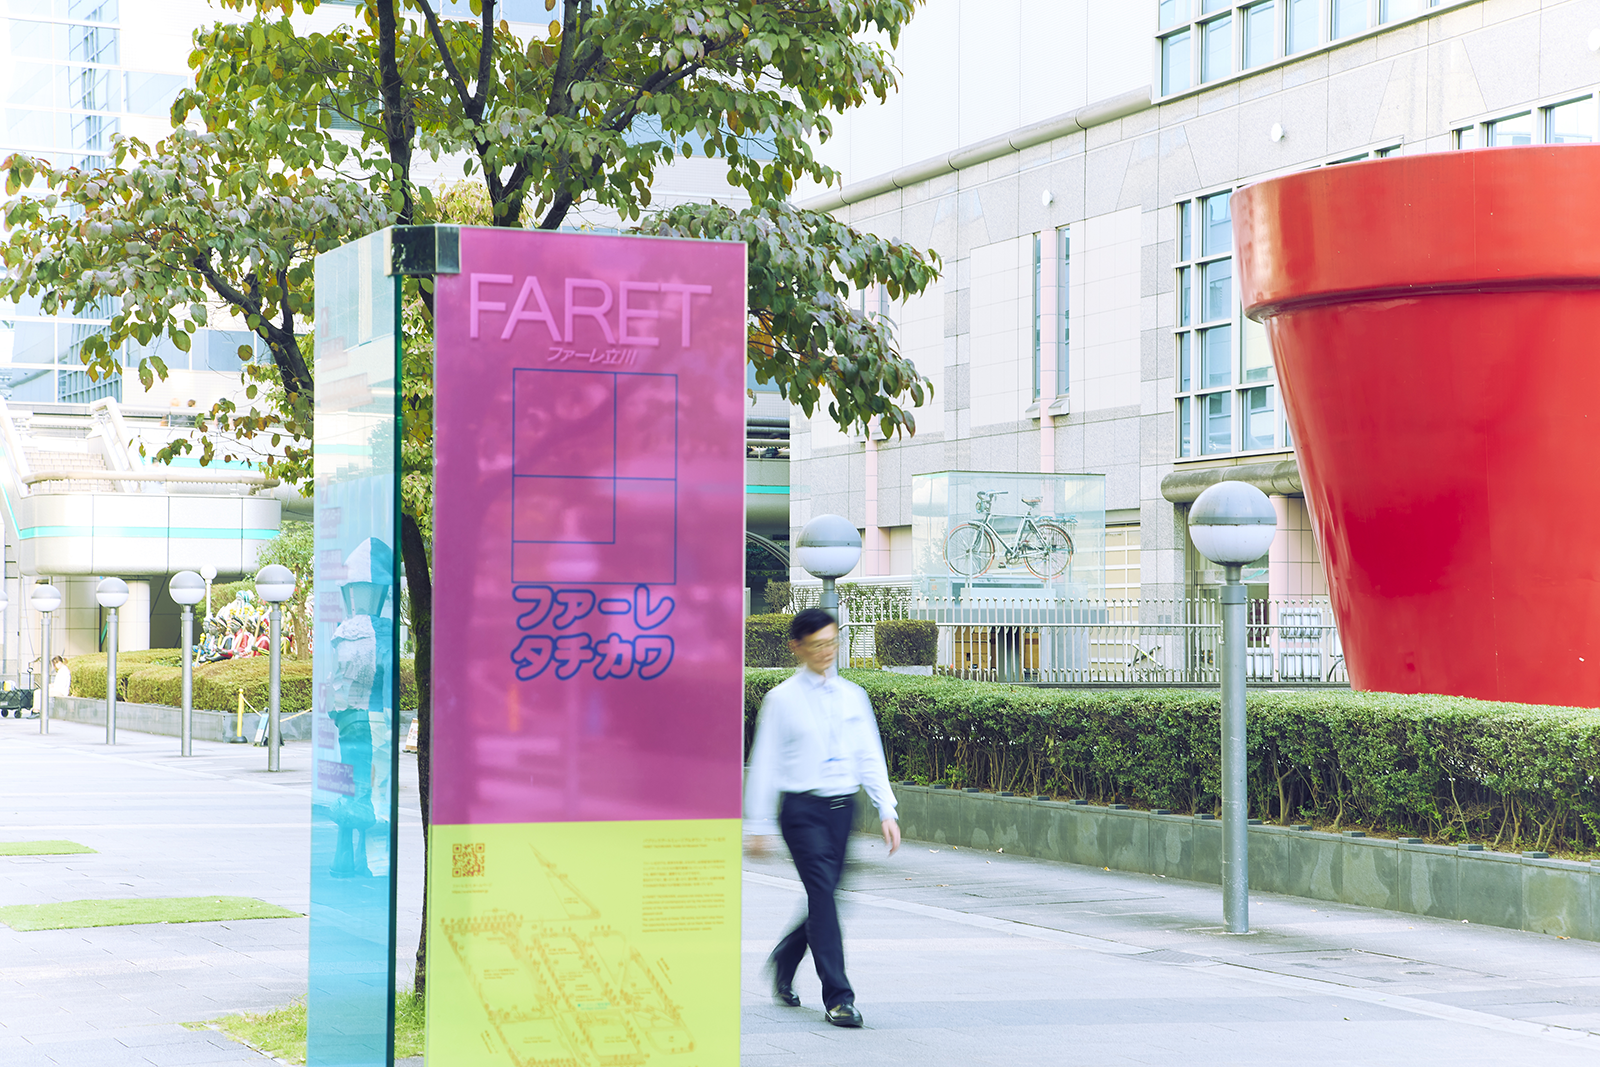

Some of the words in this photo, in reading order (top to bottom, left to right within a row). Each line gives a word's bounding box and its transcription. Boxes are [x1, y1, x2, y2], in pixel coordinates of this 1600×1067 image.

[470, 273, 712, 347] FARET
[547, 347, 637, 364] ファーレ立川
[512, 584, 675, 631] ファーレ
[510, 632, 675, 681] タチカワ
